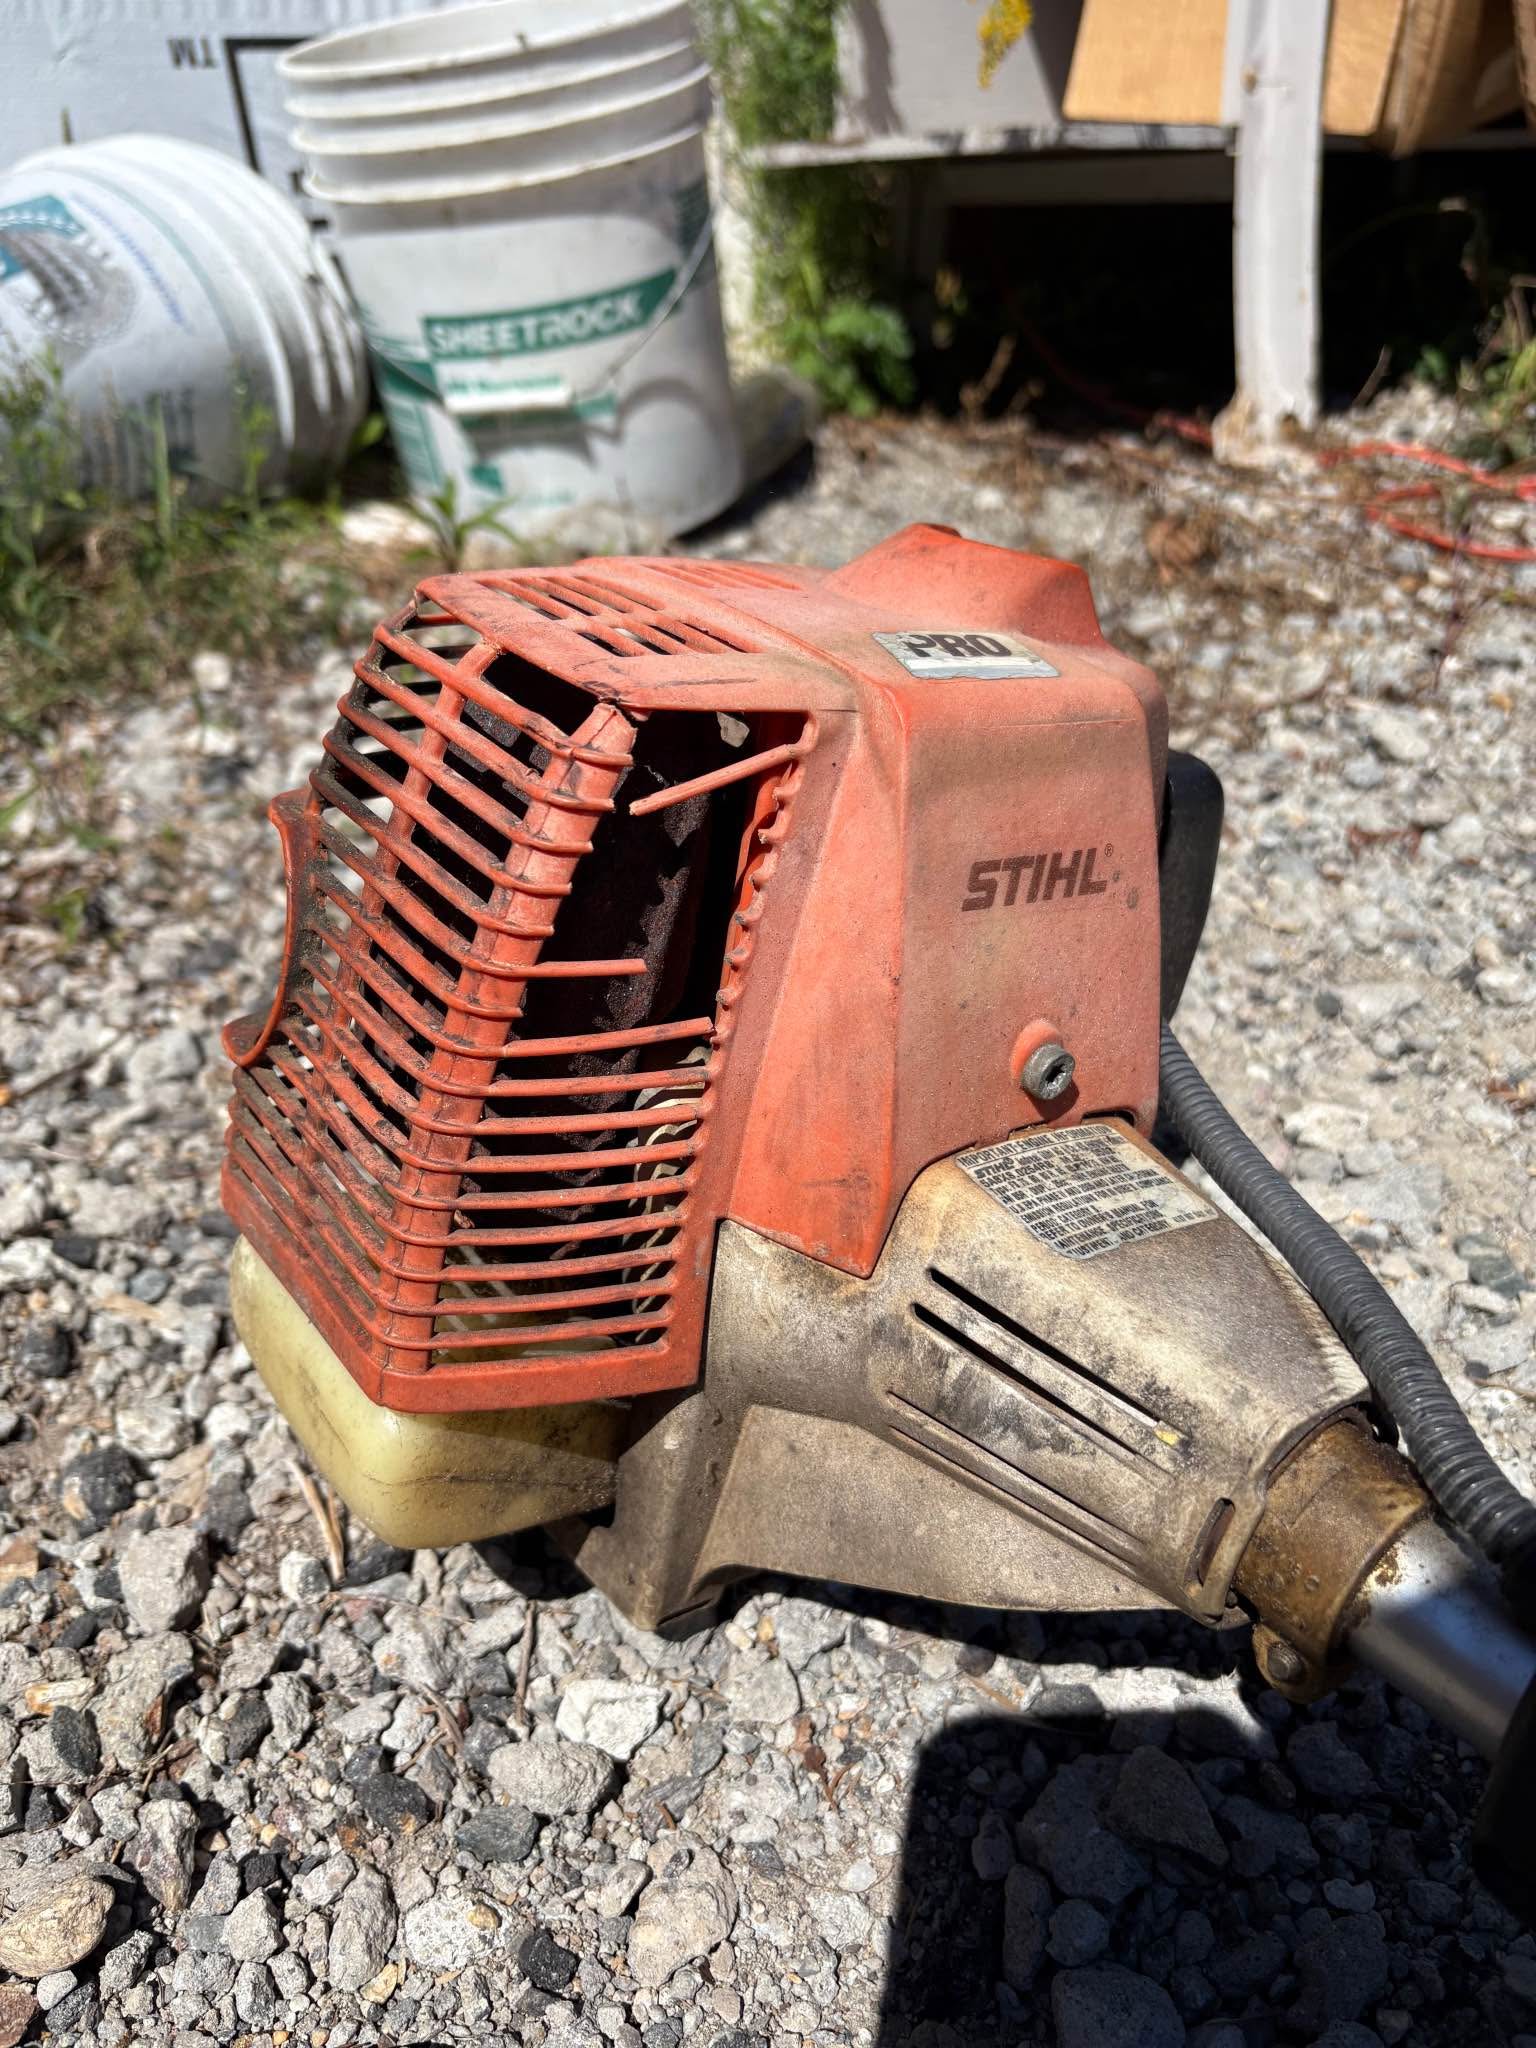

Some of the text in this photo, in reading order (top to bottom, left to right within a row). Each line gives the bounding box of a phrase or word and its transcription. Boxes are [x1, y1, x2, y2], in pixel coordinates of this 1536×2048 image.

[432, 296, 643, 354] SHEETROCK
[902, 634, 1012, 658] PRO
[962, 847, 1107, 912] STIHL
[957, 1144, 1017, 1166] IMPORTANT
[1014, 1134, 1055, 1150] ENGINE
[973, 1158, 1014, 1179] STIHL
[1018, 1205, 1056, 1223] EMISSION
[1037, 1225, 1069, 1241] REFER
[1063, 1220, 1081, 1231] TO
[1109, 1202, 1144, 1217] MANUAL
[1055, 1206, 1094, 1223] CATEGORY
[1114, 1229, 1137, 1242] AND
[1130, 1218, 1172, 1236] CATEGORY
